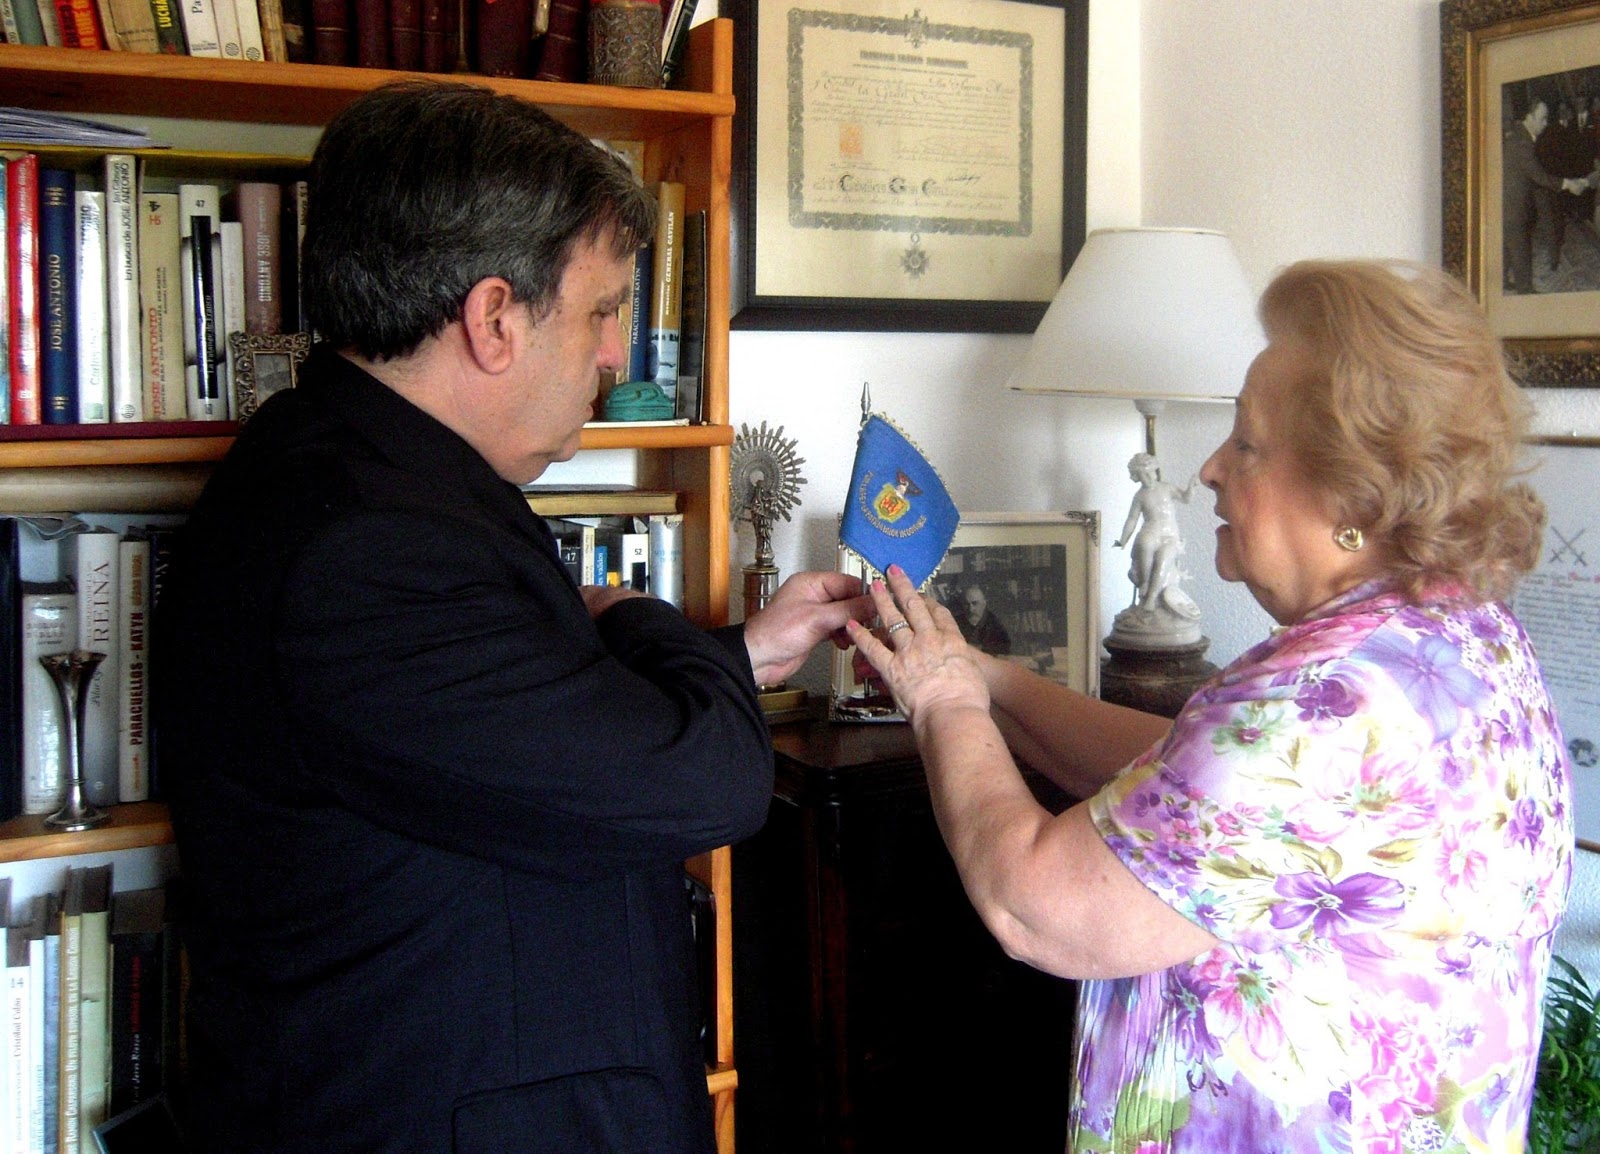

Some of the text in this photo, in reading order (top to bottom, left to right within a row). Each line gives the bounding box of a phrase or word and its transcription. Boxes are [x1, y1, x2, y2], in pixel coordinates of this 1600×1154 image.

[120, 163, 131, 205] ANTONIO
[123, 230, 132, 242] de
[124, 243, 133, 268] busca
[665, 247, 673, 282] GENERAL
[50, 254, 62, 317] ANTONIO
[633, 297, 641, 344] PARACUELLOS
[149, 307, 160, 378] ANTONIO
[564, 552, 577, 562] 47
[634, 548, 643, 556] 52
[94, 562, 110, 643] REINA
[130, 613, 144, 651] KATYN
[130, 662, 144, 746] PARACUELLOS
